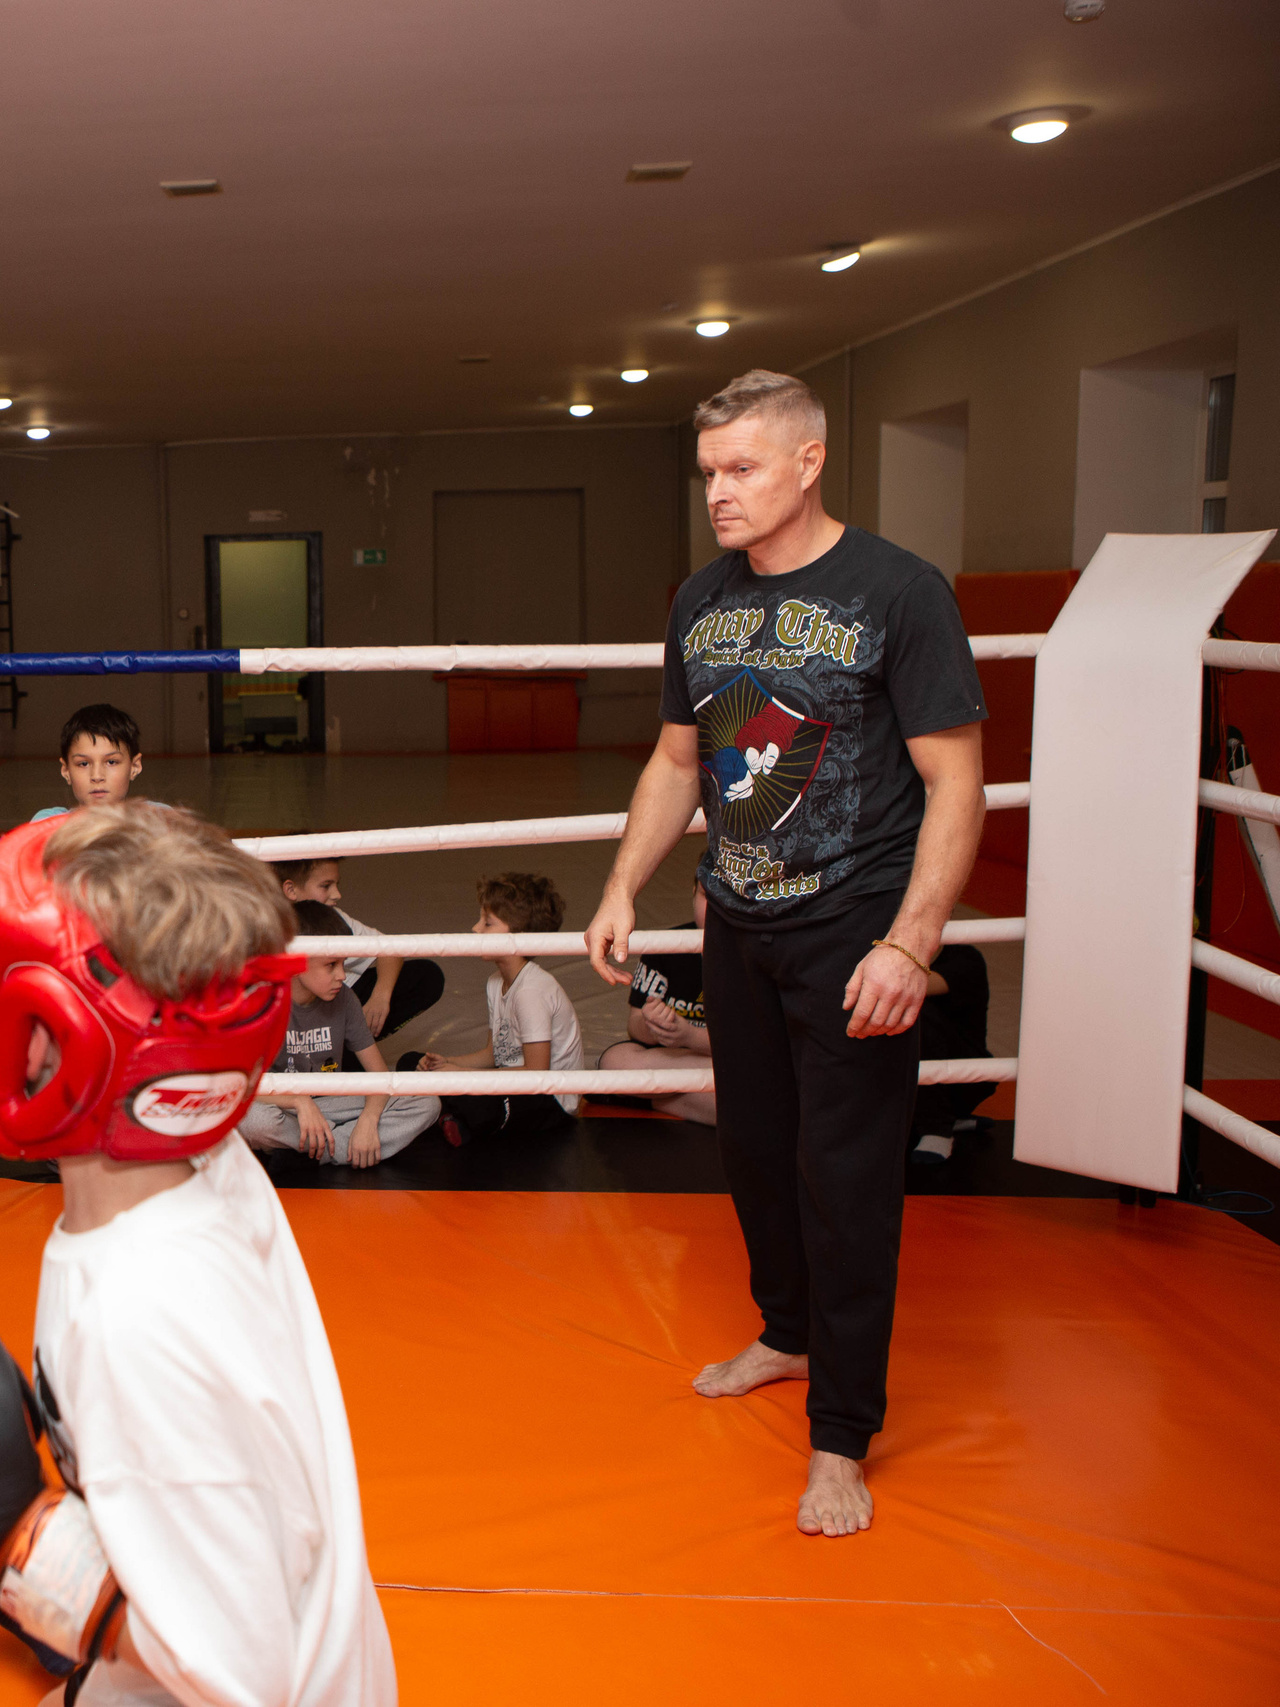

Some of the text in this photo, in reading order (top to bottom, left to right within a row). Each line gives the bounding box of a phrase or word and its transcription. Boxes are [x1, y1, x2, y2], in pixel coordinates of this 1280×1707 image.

[683, 599, 864, 667] Muay Thai
[759, 648, 807, 670] Fight
[755, 871, 822, 900] Arts
